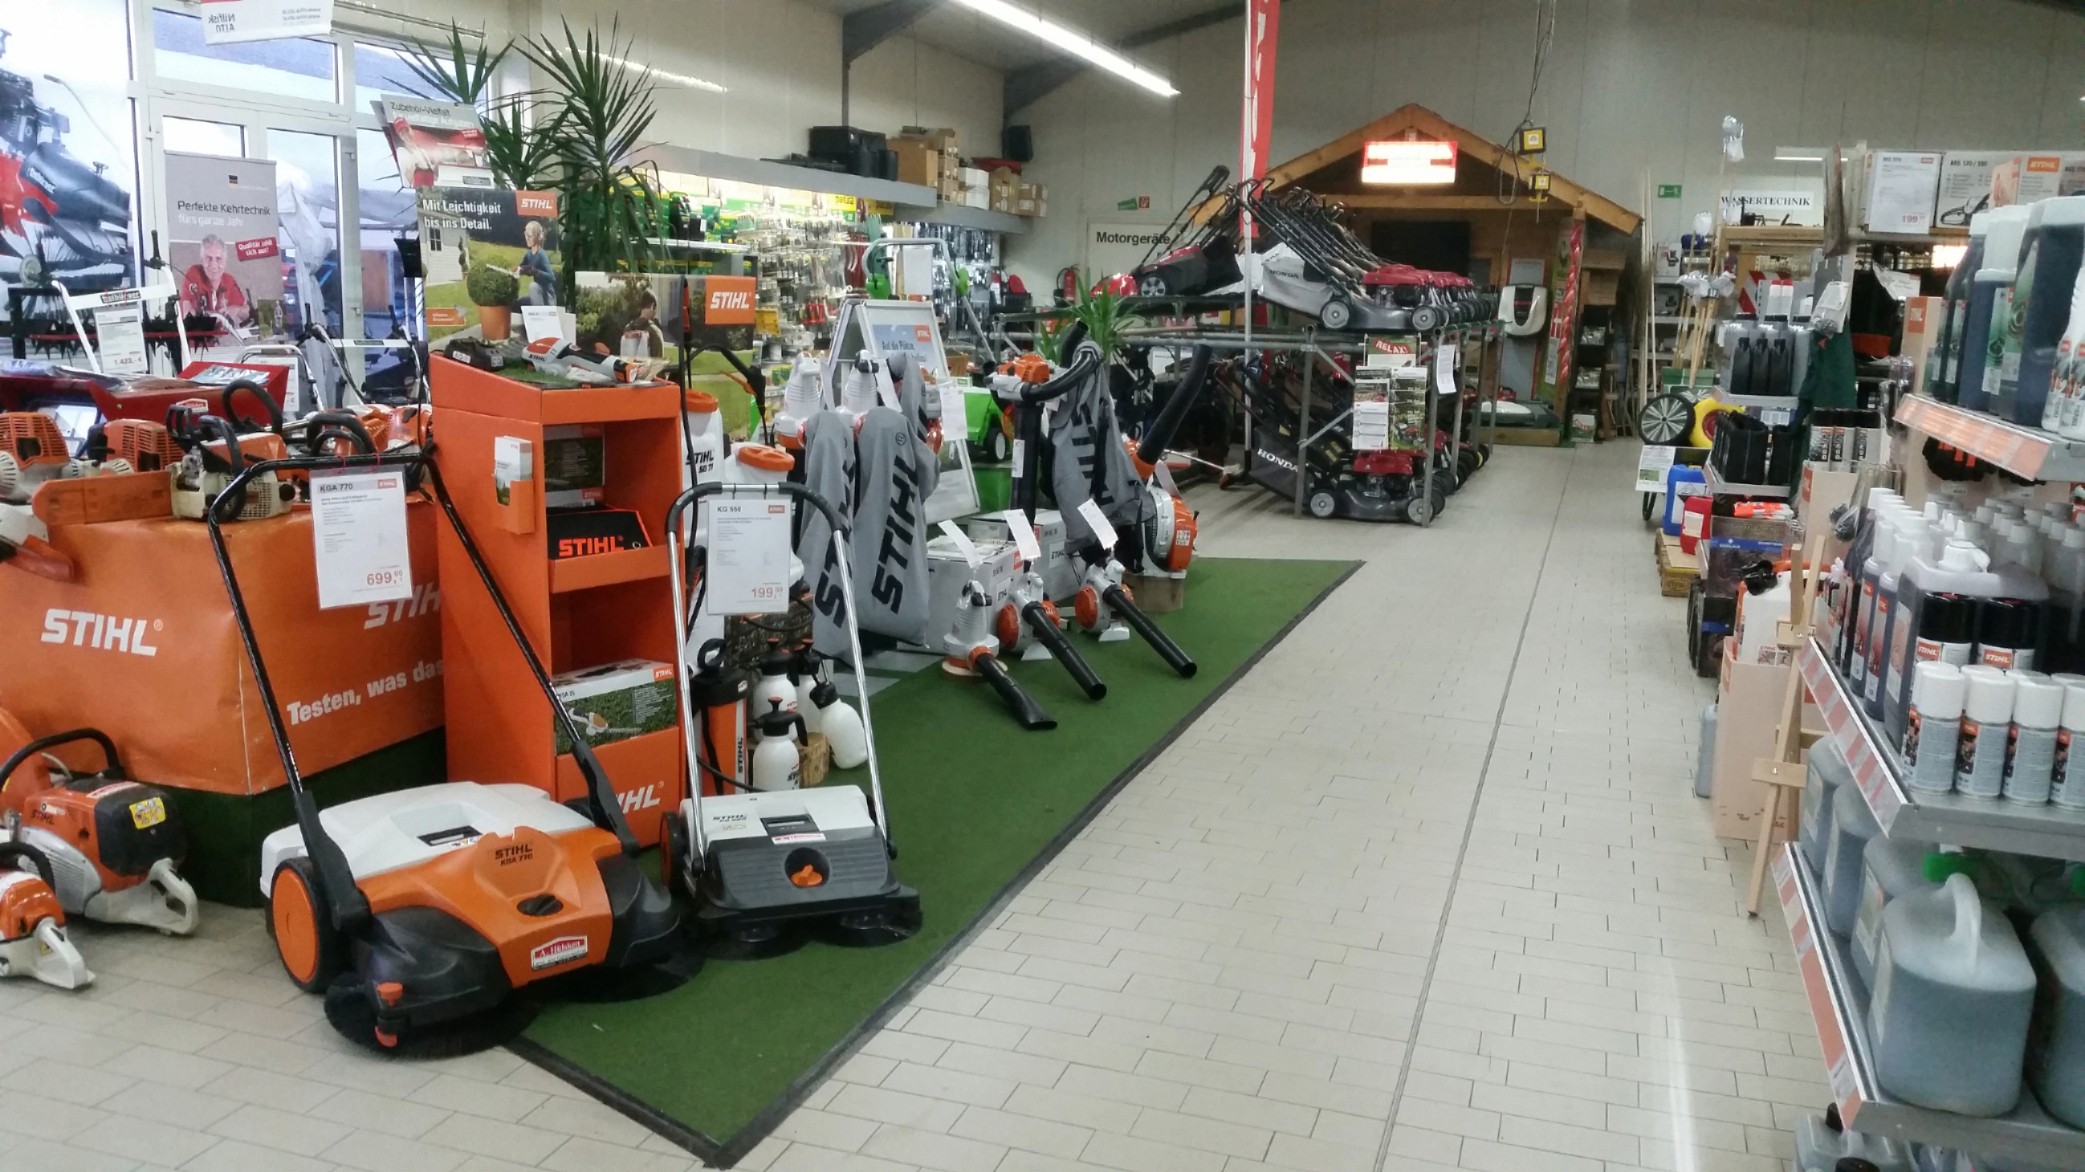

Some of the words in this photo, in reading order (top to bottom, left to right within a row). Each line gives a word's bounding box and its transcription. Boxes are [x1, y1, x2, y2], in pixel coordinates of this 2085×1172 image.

[177, 200, 218, 213] Perfekte
[220, 203, 271, 215] Kehrtechnik
[422, 199, 441, 211] Mit
[442, 201, 502, 215] Leichtigkeit
[520, 198, 553, 209] STIHL
[226, 216, 245, 227] Jahr
[424, 216, 440, 228] bis
[442, 219, 458, 229] ins
[460, 219, 493, 231] Detail.
[1096, 231, 1172, 247] Motorgeräte
[1269, 269, 1299, 279] HONDA
[710, 291, 751, 310] STIHL
[1375, 340, 1410, 354] RELAX!
[1256, 448, 1299, 473] HONDA
[320, 484, 338, 492] KGA
[340, 483, 354, 491] 770
[871, 455, 919, 615] STIHL
[559, 536, 624, 557] STIHL
[40, 608, 157, 657] STIHL
[1917, 645, 1938, 656] STIHL
[1984, 653, 2010, 663] STIHL
[286, 688, 362, 726] Testen,
[366, 671, 408, 698] was
[616, 784, 661, 815] IHL
[495, 843, 533, 859] STIHL
